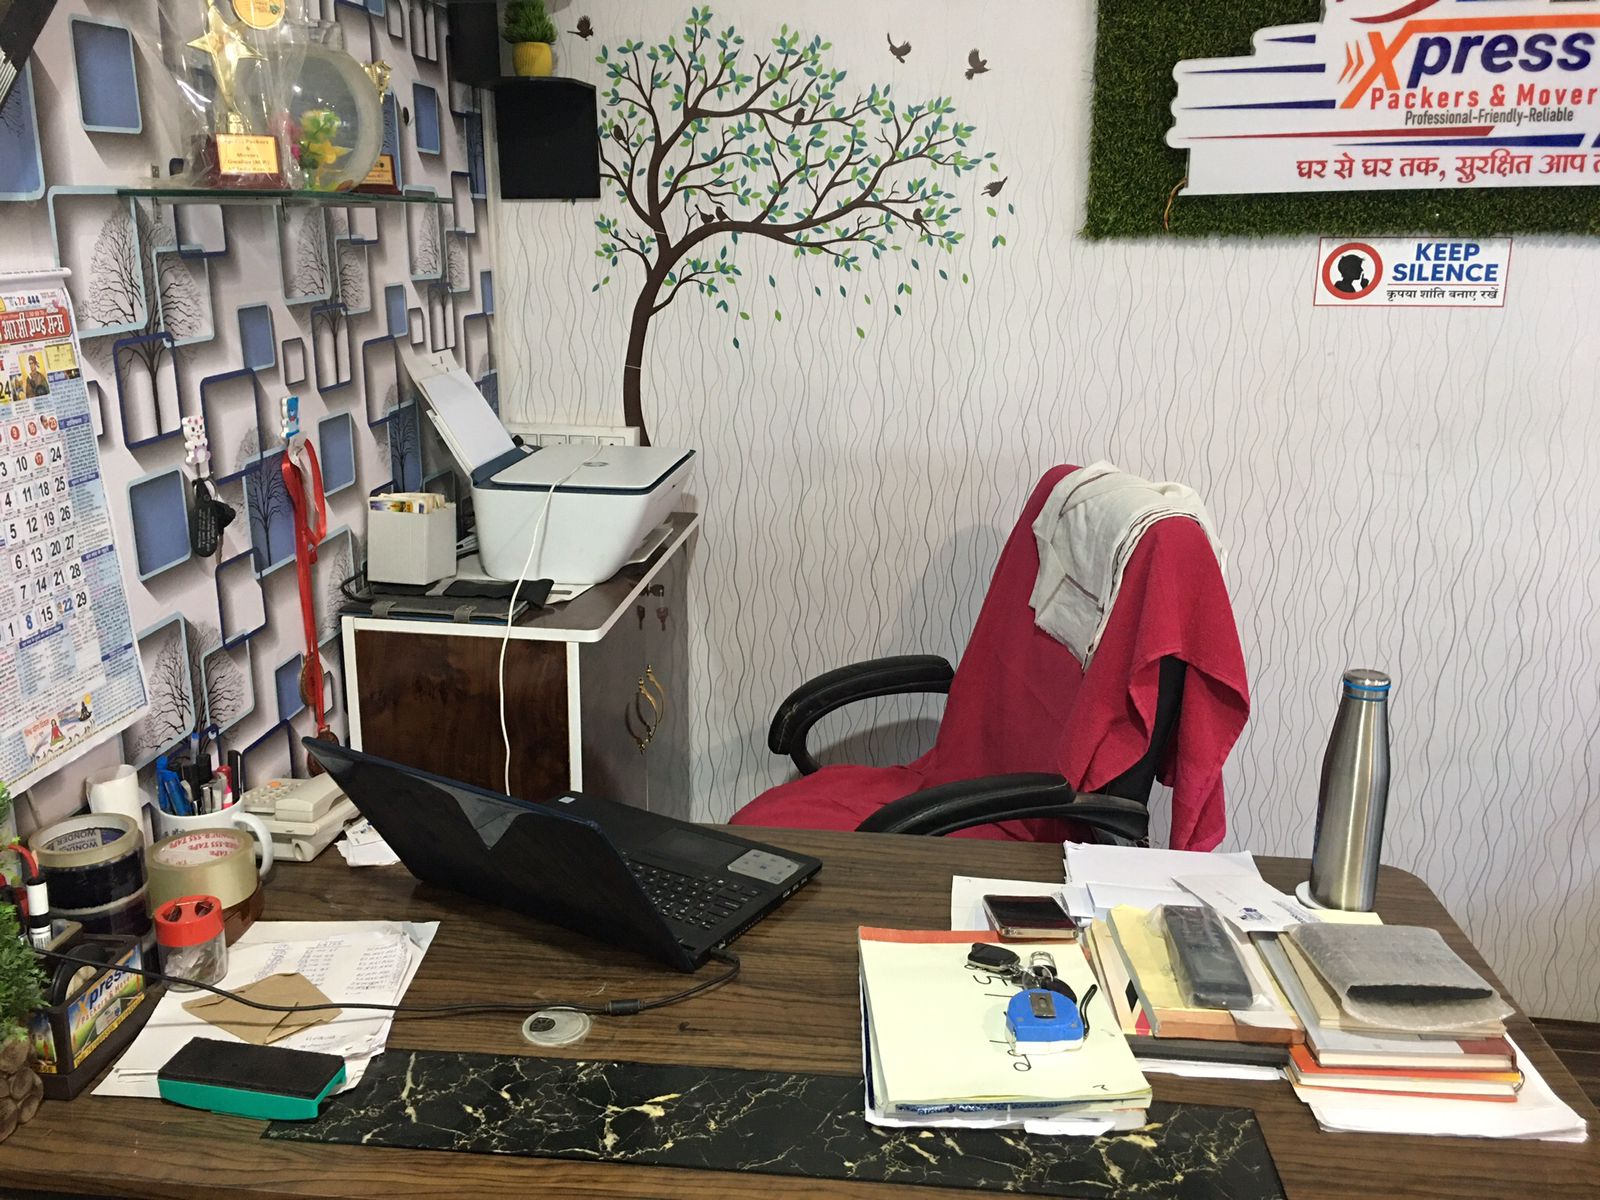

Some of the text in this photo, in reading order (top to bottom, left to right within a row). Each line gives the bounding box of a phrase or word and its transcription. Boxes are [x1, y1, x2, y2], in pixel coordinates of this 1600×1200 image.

[1340, 30, 1595, 109] Xpress
[1370, 86, 1479, 110] Packers
[1489, 84, 1505, 107] &
[1405, 107, 1574, 126] Professional-Friendly-Reliable
[1296, 159, 1327, 179] घर
[1334, 152, 1355, 180] से
[1362, 157, 1392, 178] घर
[1400, 155, 1446, 182] तक,
[1455, 148, 1532, 184] सुरक्षित
[1539, 154, 1587, 174] आप
[1416, 243, 1480, 262] KEEP
[1392, 263, 1498, 282] SILENCE
[1387, 286, 1498, 302] कृपया शांति बनाए रखें
[16, 455, 28, 472] 10
[50, 446, 62, 463] 24
[5, 492, 12, 508] 4
[22, 486, 33, 502] 11
[39, 481, 50, 497] 18
[55, 476, 66, 492] 25
[10, 505, 71, 539] 5 12 19 26
[15, 554, 22, 569] 6
[31, 547, 43, 563] 13
[50, 540, 62, 557] 20
[65, 534, 74, 550] 27
[20, 563, 81, 600] 7 14 21 28
[8, 622, 14, 637] 1
[25, 614, 33, 630] 8
[41, 605, 53, 622] 15
[63, 598, 74, 613] 22
[76, 591, 87, 608] 29
[57, 830, 96, 845] WONDER
[188, 842, 209, 850] TAPE
